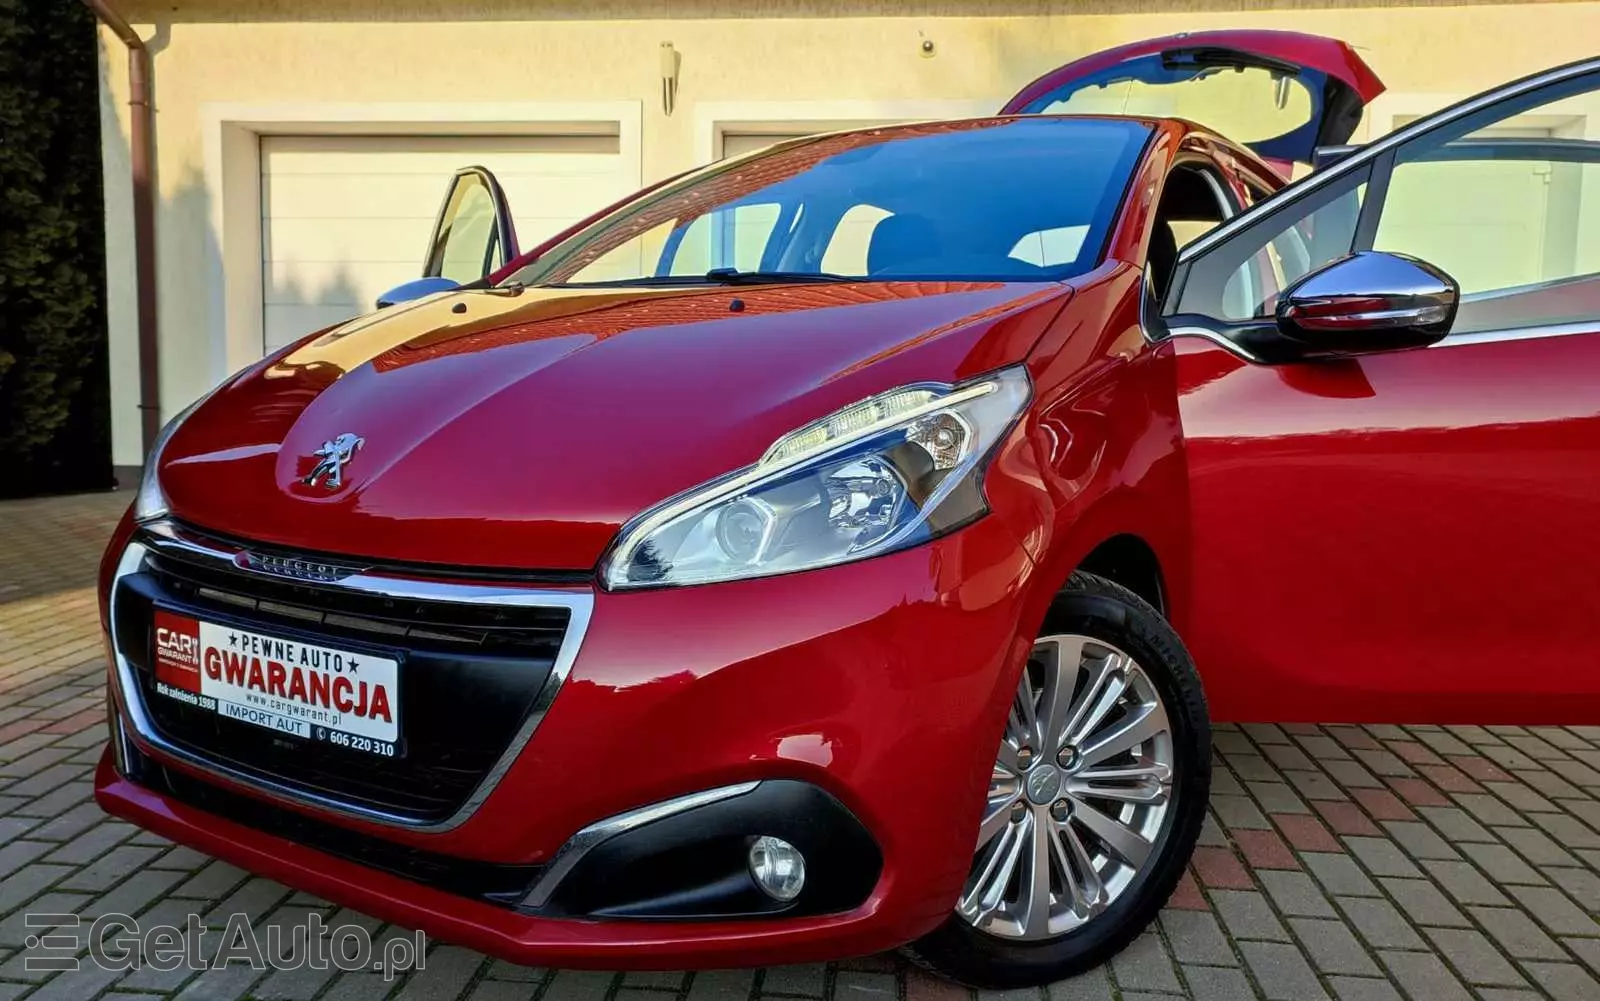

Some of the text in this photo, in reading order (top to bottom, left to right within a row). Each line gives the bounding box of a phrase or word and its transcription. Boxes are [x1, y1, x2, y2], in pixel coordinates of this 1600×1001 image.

[262, 555, 338, 575] PEUGEOT
[156, 627, 192, 653] CAR
[242, 634, 343, 673] PEWNE AUTO
[157, 647, 192, 664] GWARANT
[157, 682, 169, 696] Rok
[198, 695, 216, 711] 1988
[204, 646, 393, 724] GWARANCJA
[225, 703, 303, 735] IMPORT AUT
[246, 693, 343, 726] www.cargwarant.pl
[330, 731, 394, 757] 606 220 310
